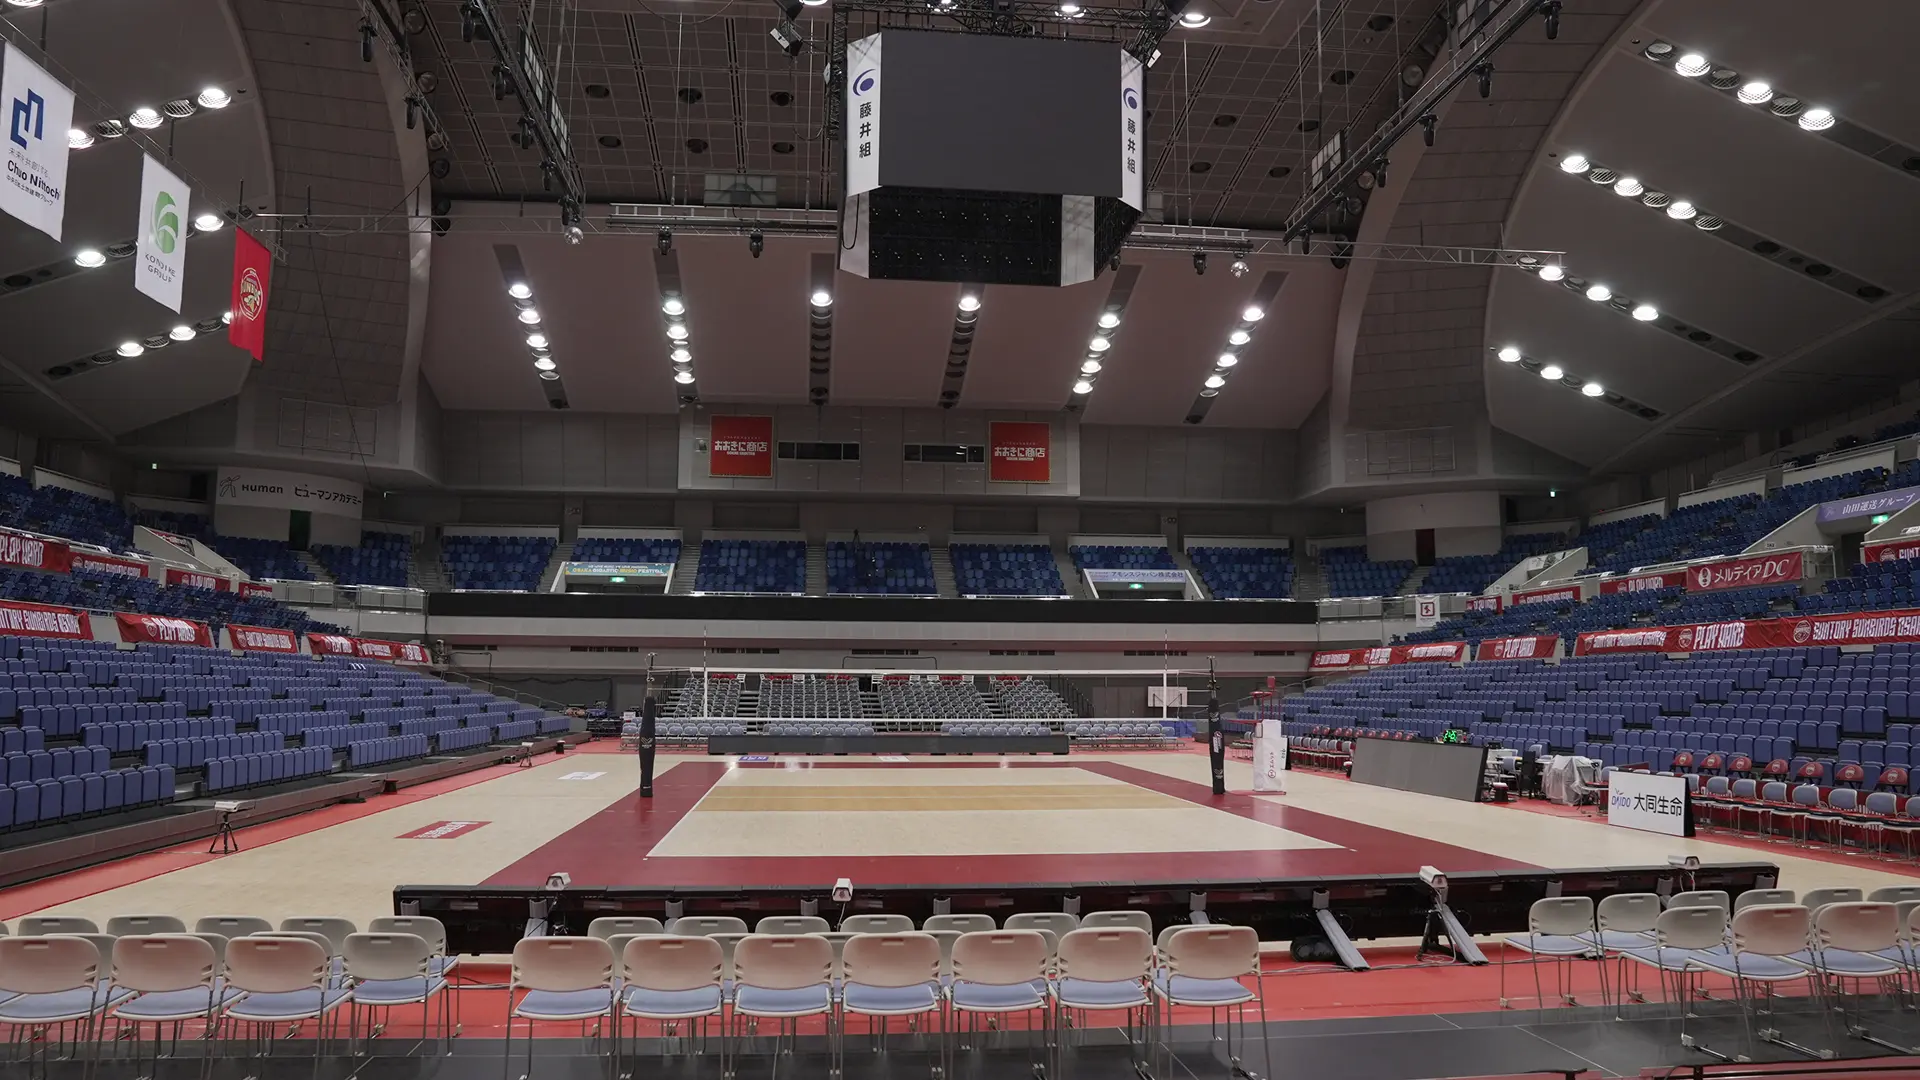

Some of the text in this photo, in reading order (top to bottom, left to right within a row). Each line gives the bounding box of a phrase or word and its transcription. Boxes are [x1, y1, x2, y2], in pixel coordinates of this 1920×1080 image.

[859, 101, 872, 159] 藤井組
[1127, 117, 1136, 174] 藤井組
[7, 159, 28, 181] Chuo
[241, 483, 362, 505] Human ヒューマンアカデミー
[1842, 493, 1916, 515] 山田運送グループ
[1714, 558, 1790, 584] メルディアDC
[1693, 624, 1720, 650] PLAY
[1812, 620, 1853, 641] SUNTORY
[1633, 793, 1683, 817] 大同生命
